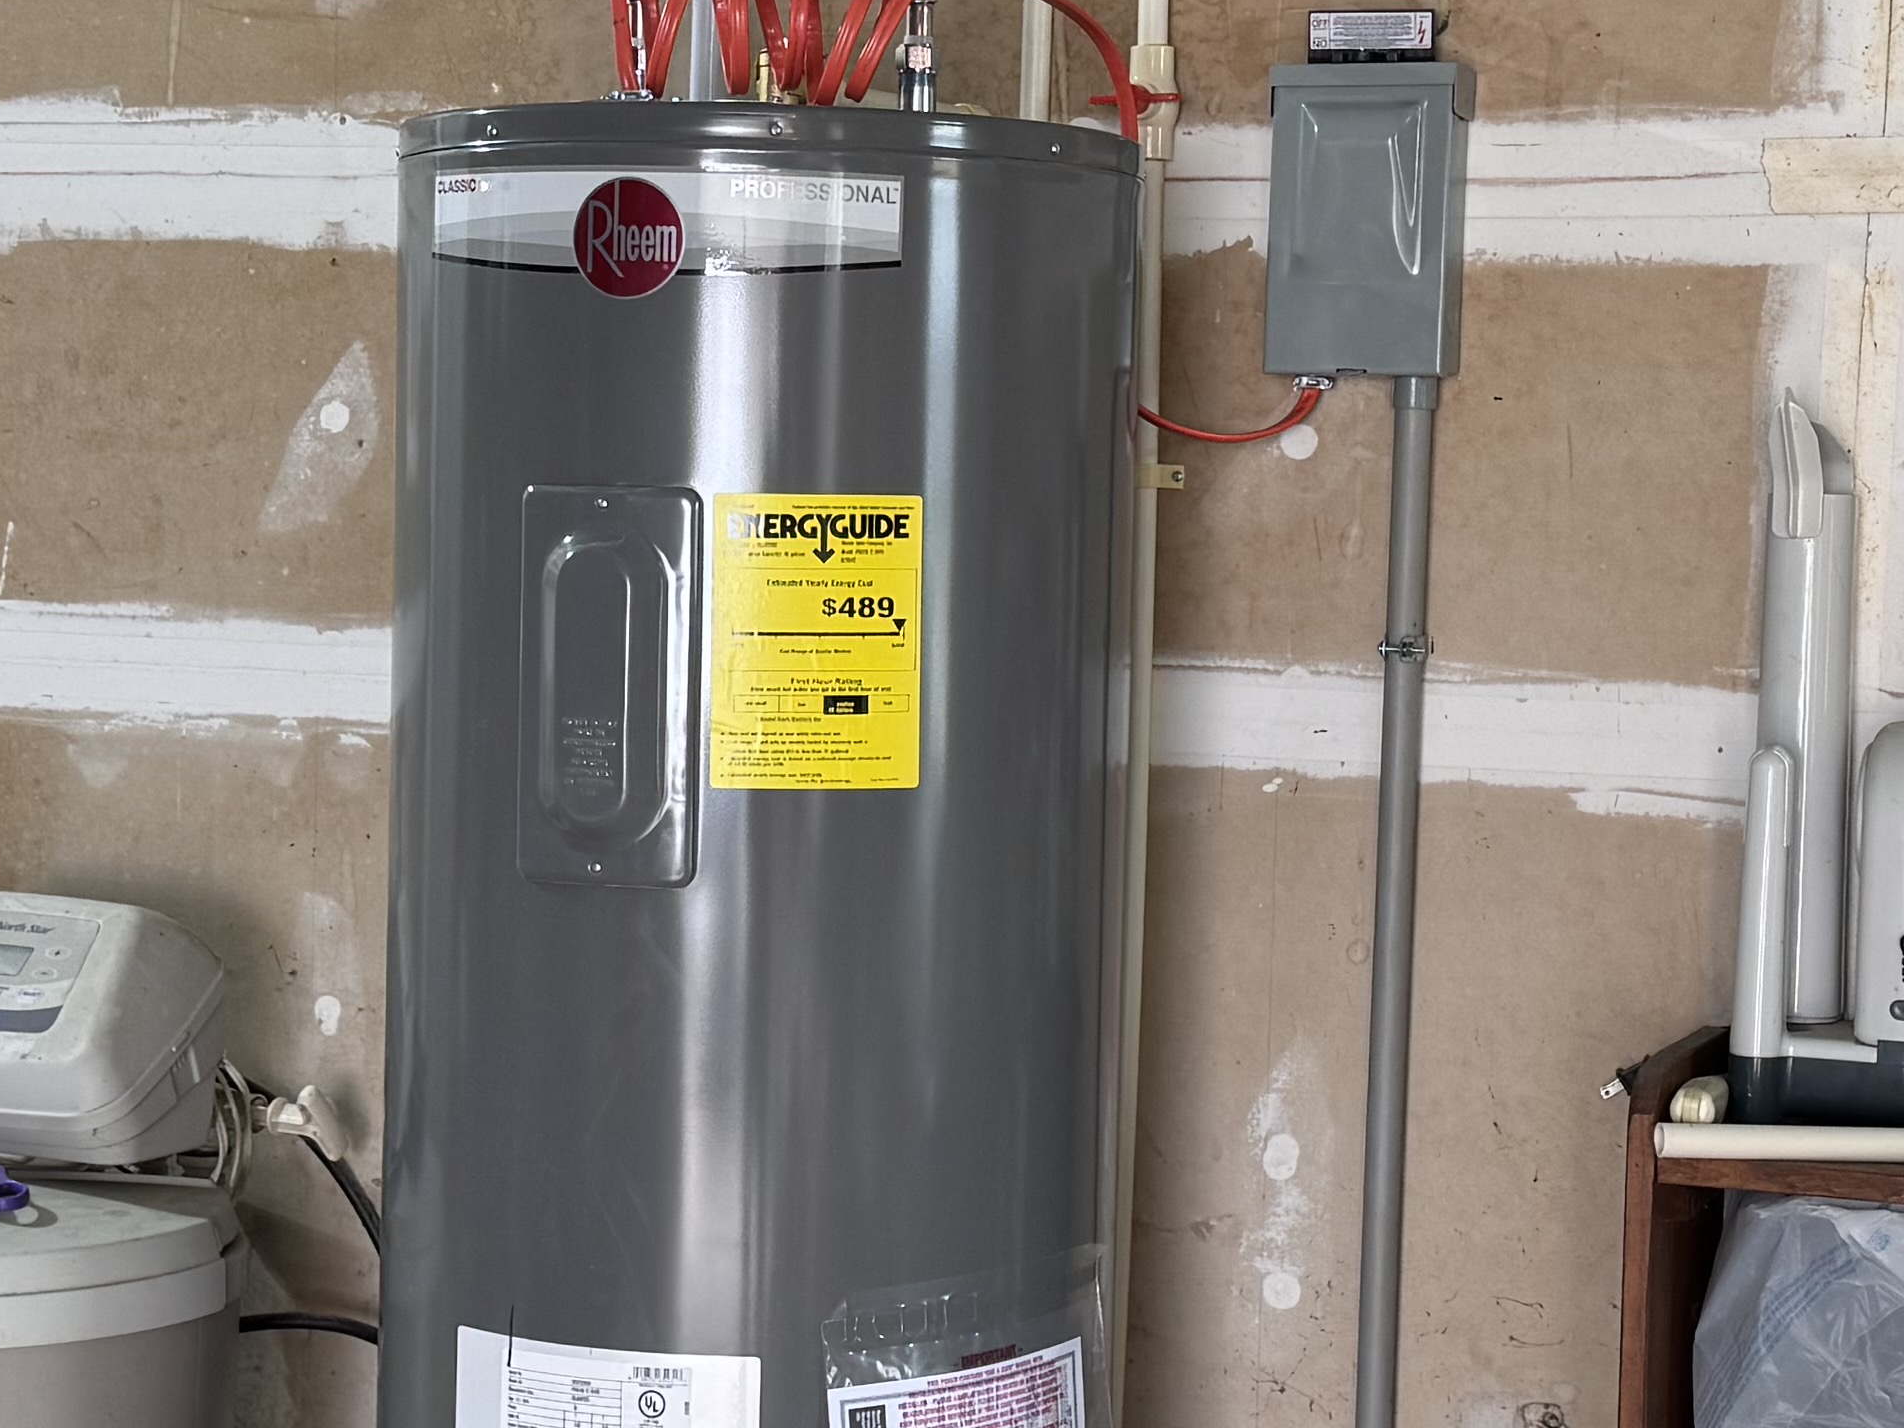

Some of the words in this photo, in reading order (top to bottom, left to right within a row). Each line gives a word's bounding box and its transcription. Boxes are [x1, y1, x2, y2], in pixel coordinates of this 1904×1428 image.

[437, 178, 477, 194] CLASSIC
[730, 178, 898, 205] PROFESSONAL
[587, 179, 678, 278] Rheem
[822, 596, 895, 618] $489
